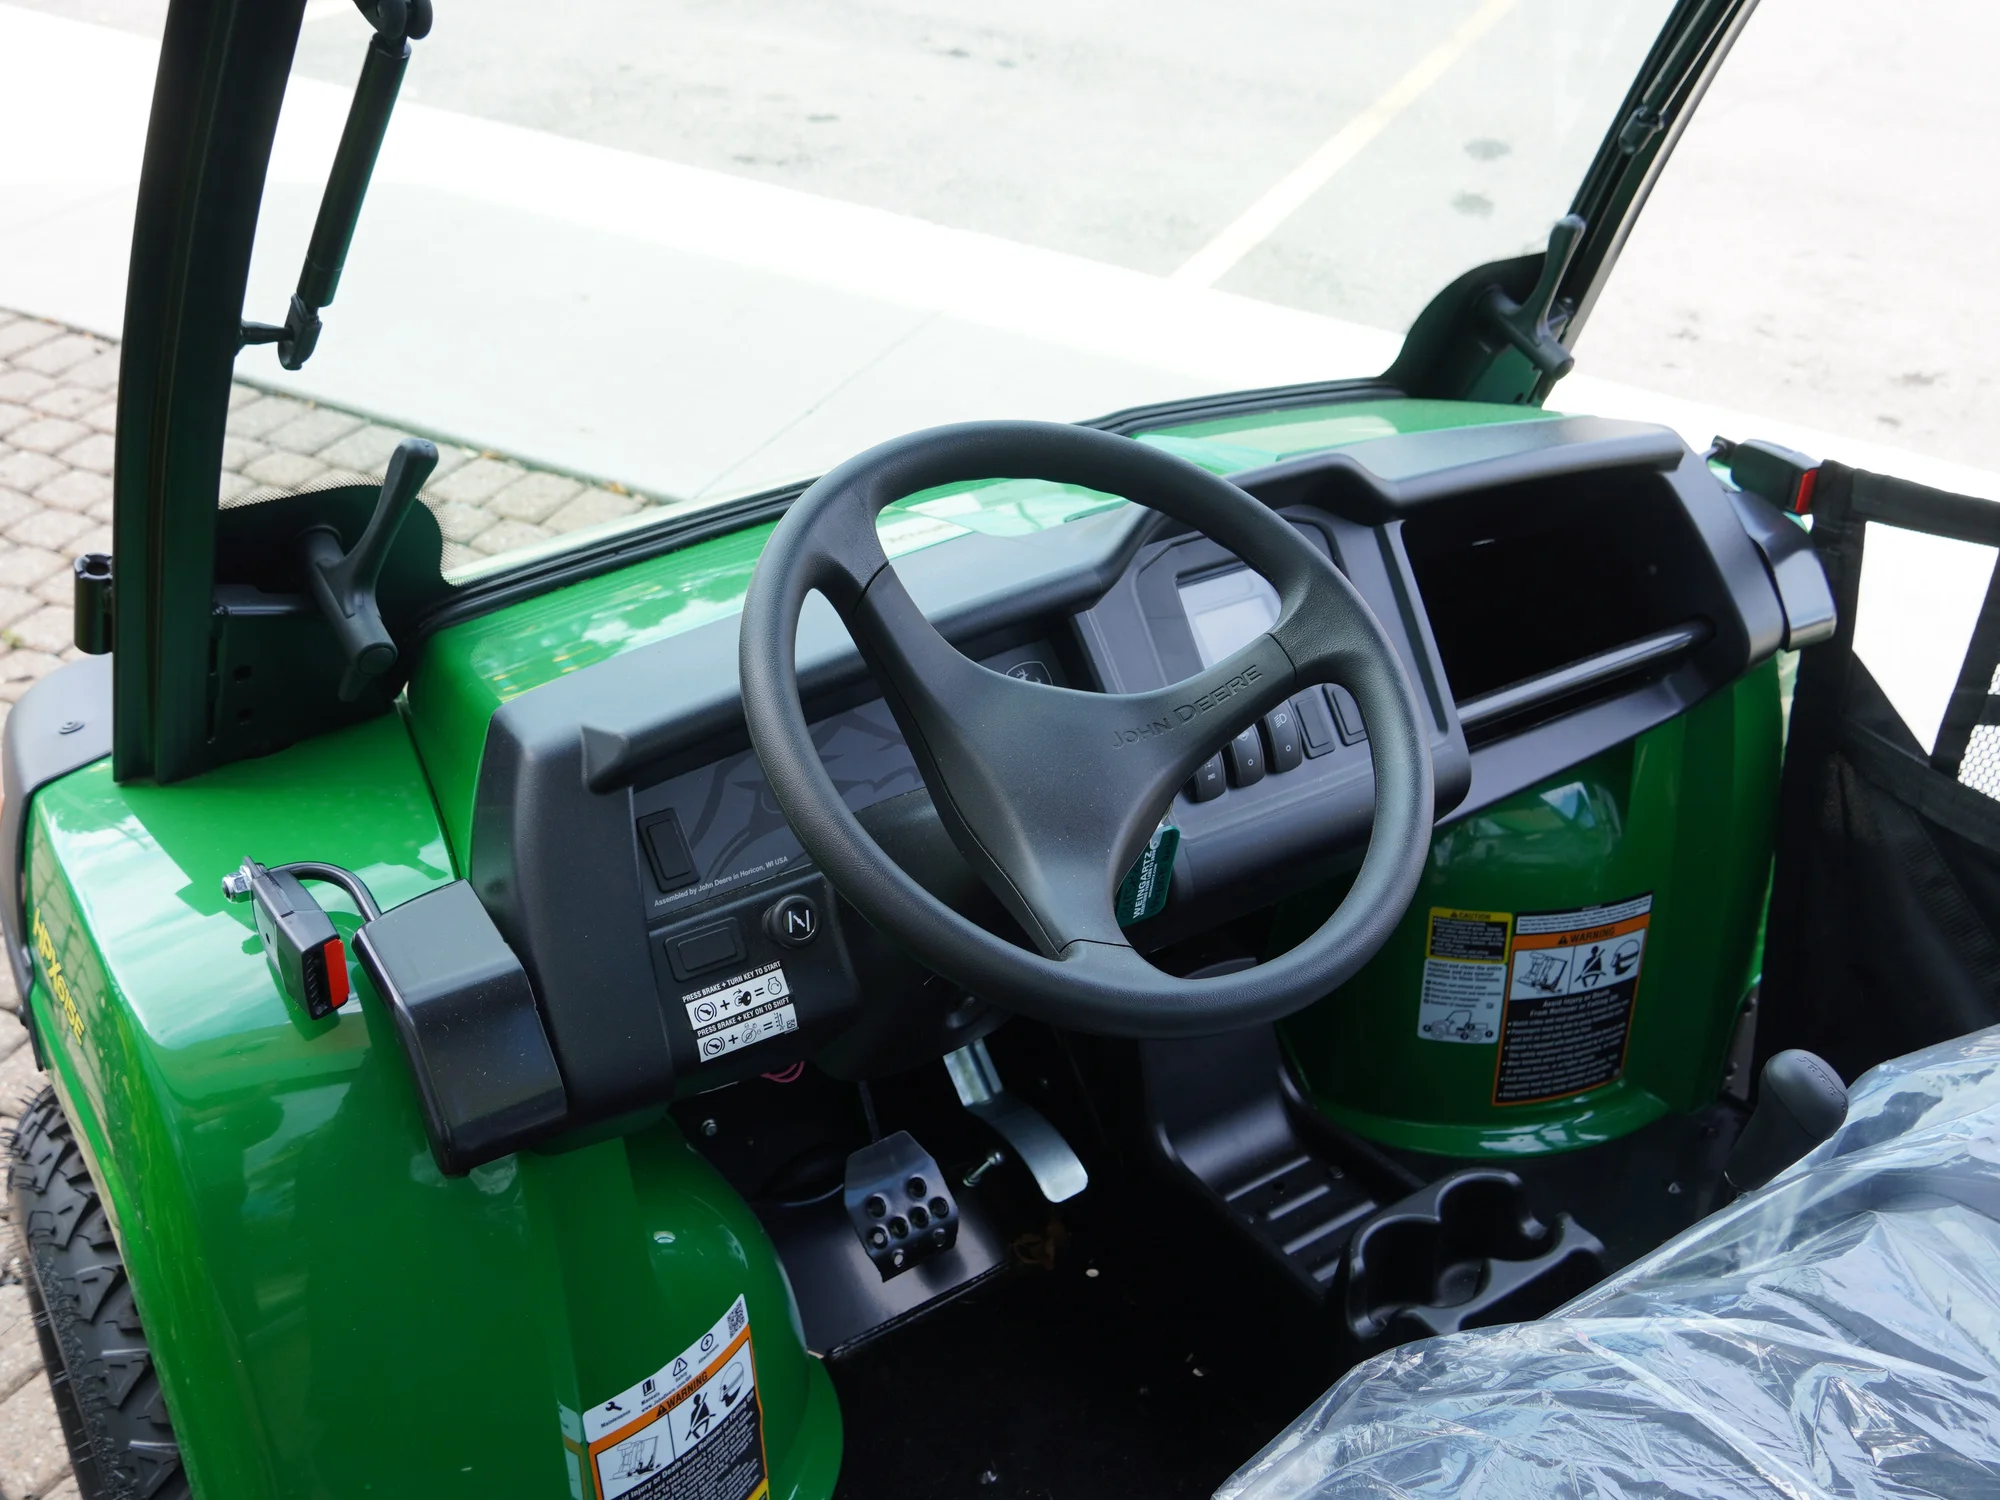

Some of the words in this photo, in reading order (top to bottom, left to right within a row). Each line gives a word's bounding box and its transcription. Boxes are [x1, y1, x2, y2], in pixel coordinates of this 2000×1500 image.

[1112, 717, 1174, 750] JOHN
[1173, 664, 1263, 726] DEERE
[654, 890, 689, 907] Assembled
[689, 888, 697, 896] by
[698, 882, 714, 892] John
[714, 877, 732, 887] Deere
[739, 865, 766, 878] Horicon,
[765, 860, 775, 869] WI
[775, 855, 788, 866] USA
[1132, 850, 1153, 919] WEINGARTZ
[1458, 911, 1492, 920] CAUTION
[1570, 926, 1615, 943] WARNING
[32, 907, 85, 1046] HPX615E
[682, 992, 702, 1003] PRESS
[701, 983, 721, 996] BRAKE
[727, 976, 743, 987] TURN
[743, 971, 754, 981] KEY
[754, 967, 763, 975] TO
[763, 960, 781, 972] START
[697, 1026, 717, 1037] PRESS
[717, 1017, 737, 1030] BRAKE
[742, 1012, 754, 1021] KEY
[754, 1008, 763, 1016] ON
[764, 1004, 773, 1012] TO
[773, 996, 790, 1009] SHIFT
[641, 1392, 660, 1406] Manuals
[666, 1371, 708, 1409] WARNING
[600, 1410, 631, 1428] Maintenance
[630, 1481, 652, 1498] Injury
[652, 1475, 661, 1485] or
[661, 1460, 682, 1479] Death
[682, 1448, 698, 1464] from
[697, 1426, 723, 1452] Rollover
[722, 1419, 730, 1429] or
